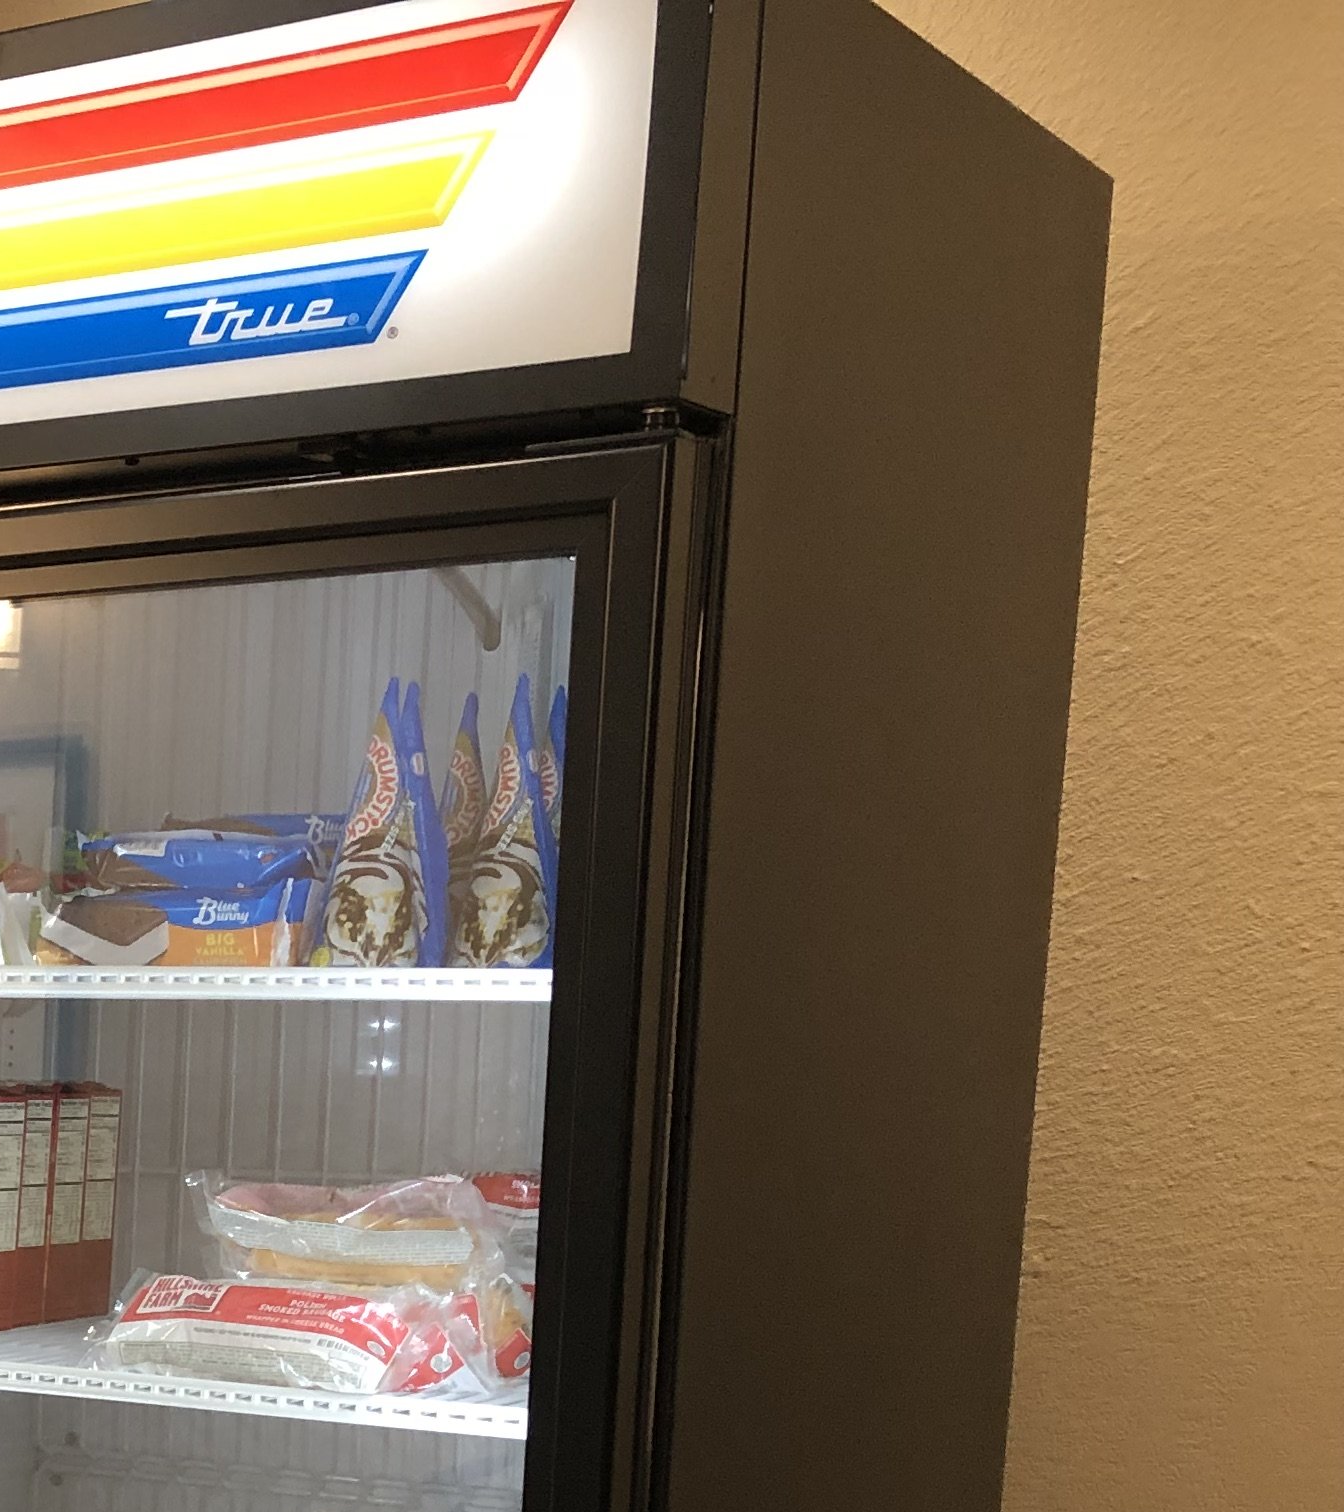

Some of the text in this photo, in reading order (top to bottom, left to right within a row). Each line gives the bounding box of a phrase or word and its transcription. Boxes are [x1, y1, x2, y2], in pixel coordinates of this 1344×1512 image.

[346, 735, 400, 843] DRUMSTICK
[206, 933, 236, 946] BIG
[143, 1290, 182, 1309] FARM
[258, 1303, 301, 1315] SMOKED
